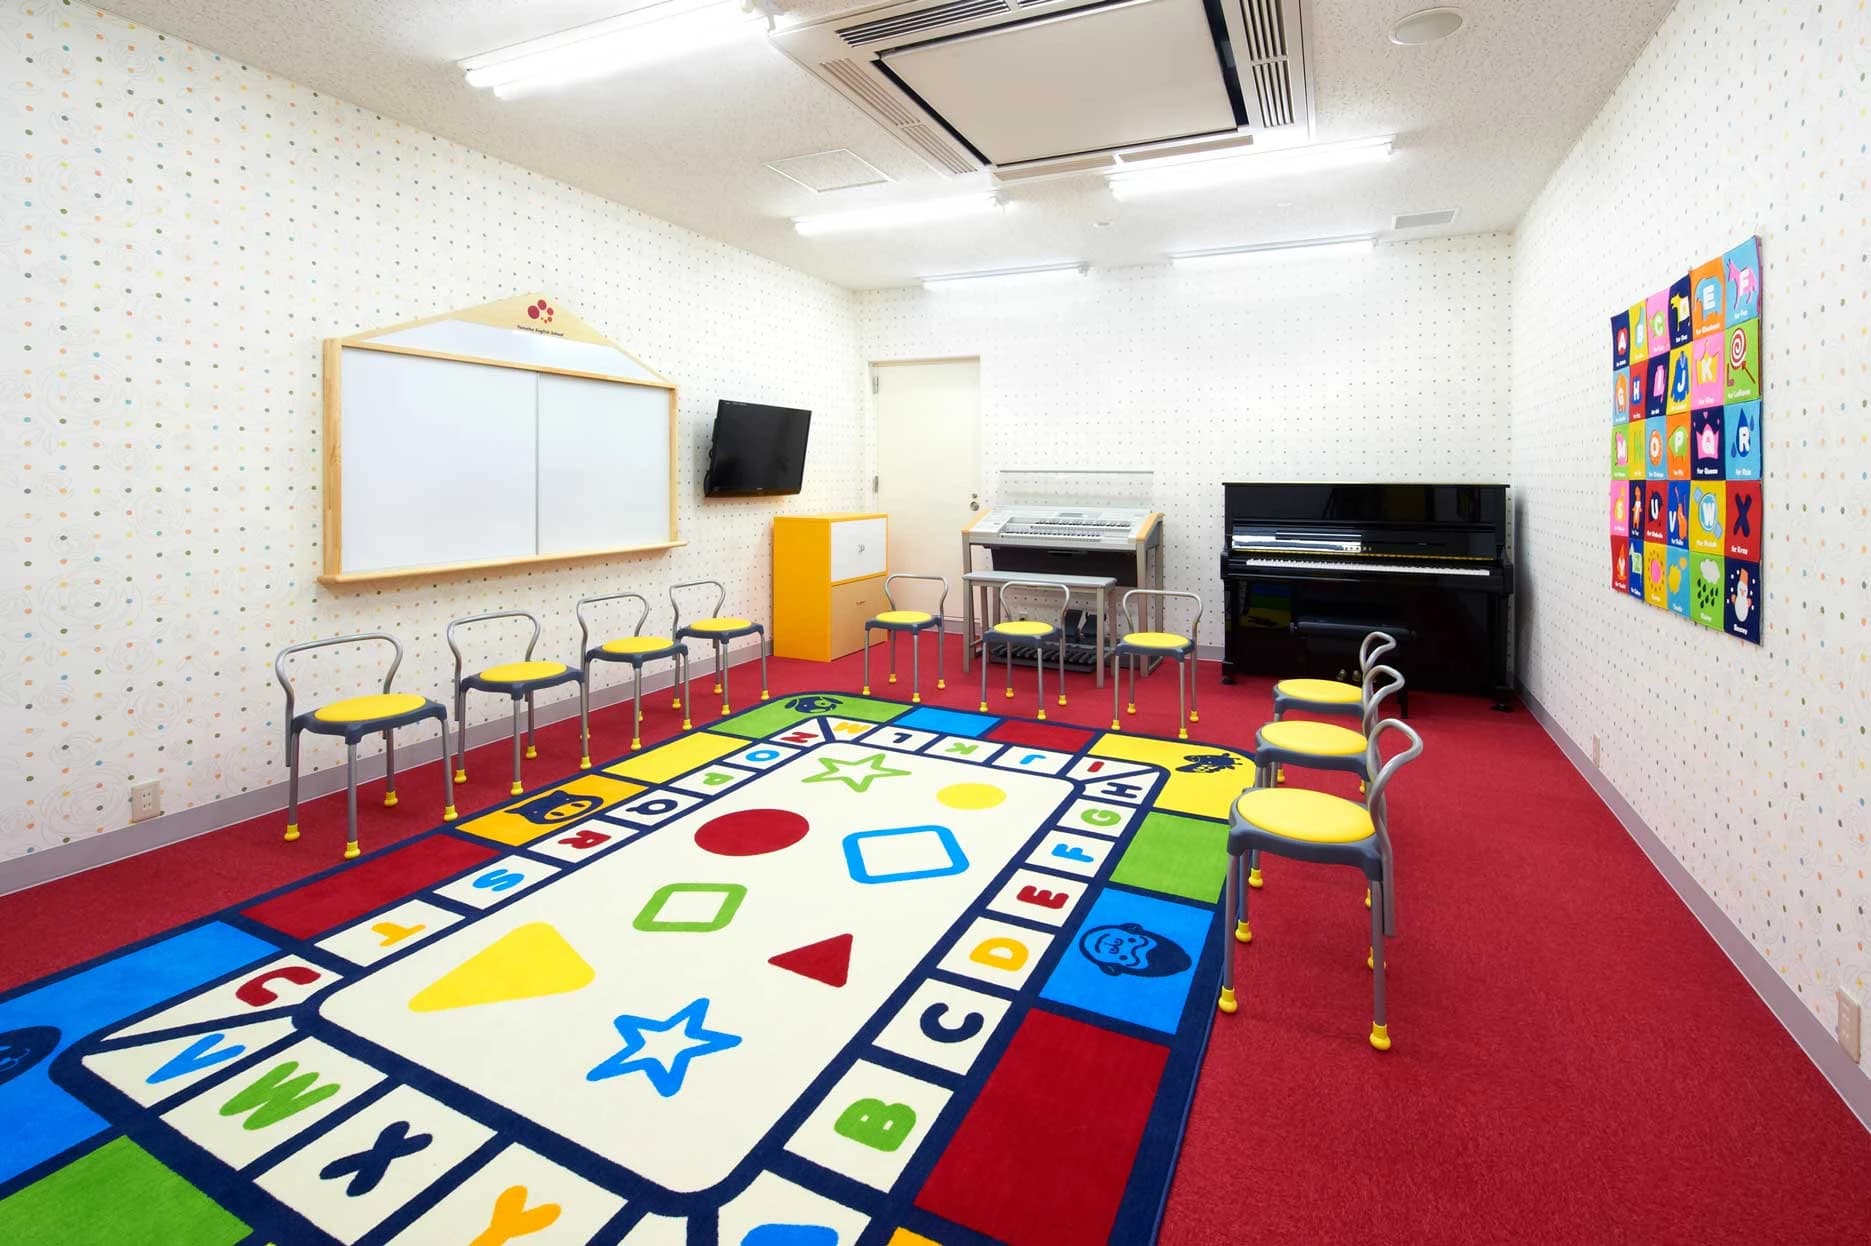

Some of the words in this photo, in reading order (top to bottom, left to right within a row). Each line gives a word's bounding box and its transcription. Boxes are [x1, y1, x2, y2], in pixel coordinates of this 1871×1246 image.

[1740, 271, 1750, 297] F
[1703, 285, 1716, 310] E
[1655, 314, 1664, 336] C
[1618, 331, 1627, 352] A
[1677, 369, 1686, 393] J
[1702, 356, 1713, 384] K
[1633, 380, 1641, 401] H
[1675, 430, 1684, 453] P
[1739, 426, 1750, 452] R
[1651, 498, 1659, 520] U
[1702, 502, 1715, 527] W
[1733, 493, 1753, 538] X
[1669, 510, 1677, 533] V
[780, 731, 819, 744] N
[833, 721, 870, 735] M
[891, 732, 913, 744] L
[746, 749, 780, 762] O
[946, 741, 979, 755] K
[1018, 754, 1047, 766] J
[703, 772, 734, 786] P
[1102, 782, 1143, 799] H
[625, 799, 678, 815] Q
[1081, 808, 1122, 827] G
[558, 830, 611, 849] R
[1052, 843, 1095, 863] F
[472, 868, 525, 892] S
[1017, 885, 1070, 910] E
[371, 921, 427, 947] T
[969, 937, 1029, 973] D
[920, 1002, 985, 1043] C
[145, 1032, 246, 1084] V
[218, 1060, 341, 1131] W
[834, 1097, 917, 1152] B
[319, 1120, 433, 1197] X
[468, 1185, 562, 1246] Y
